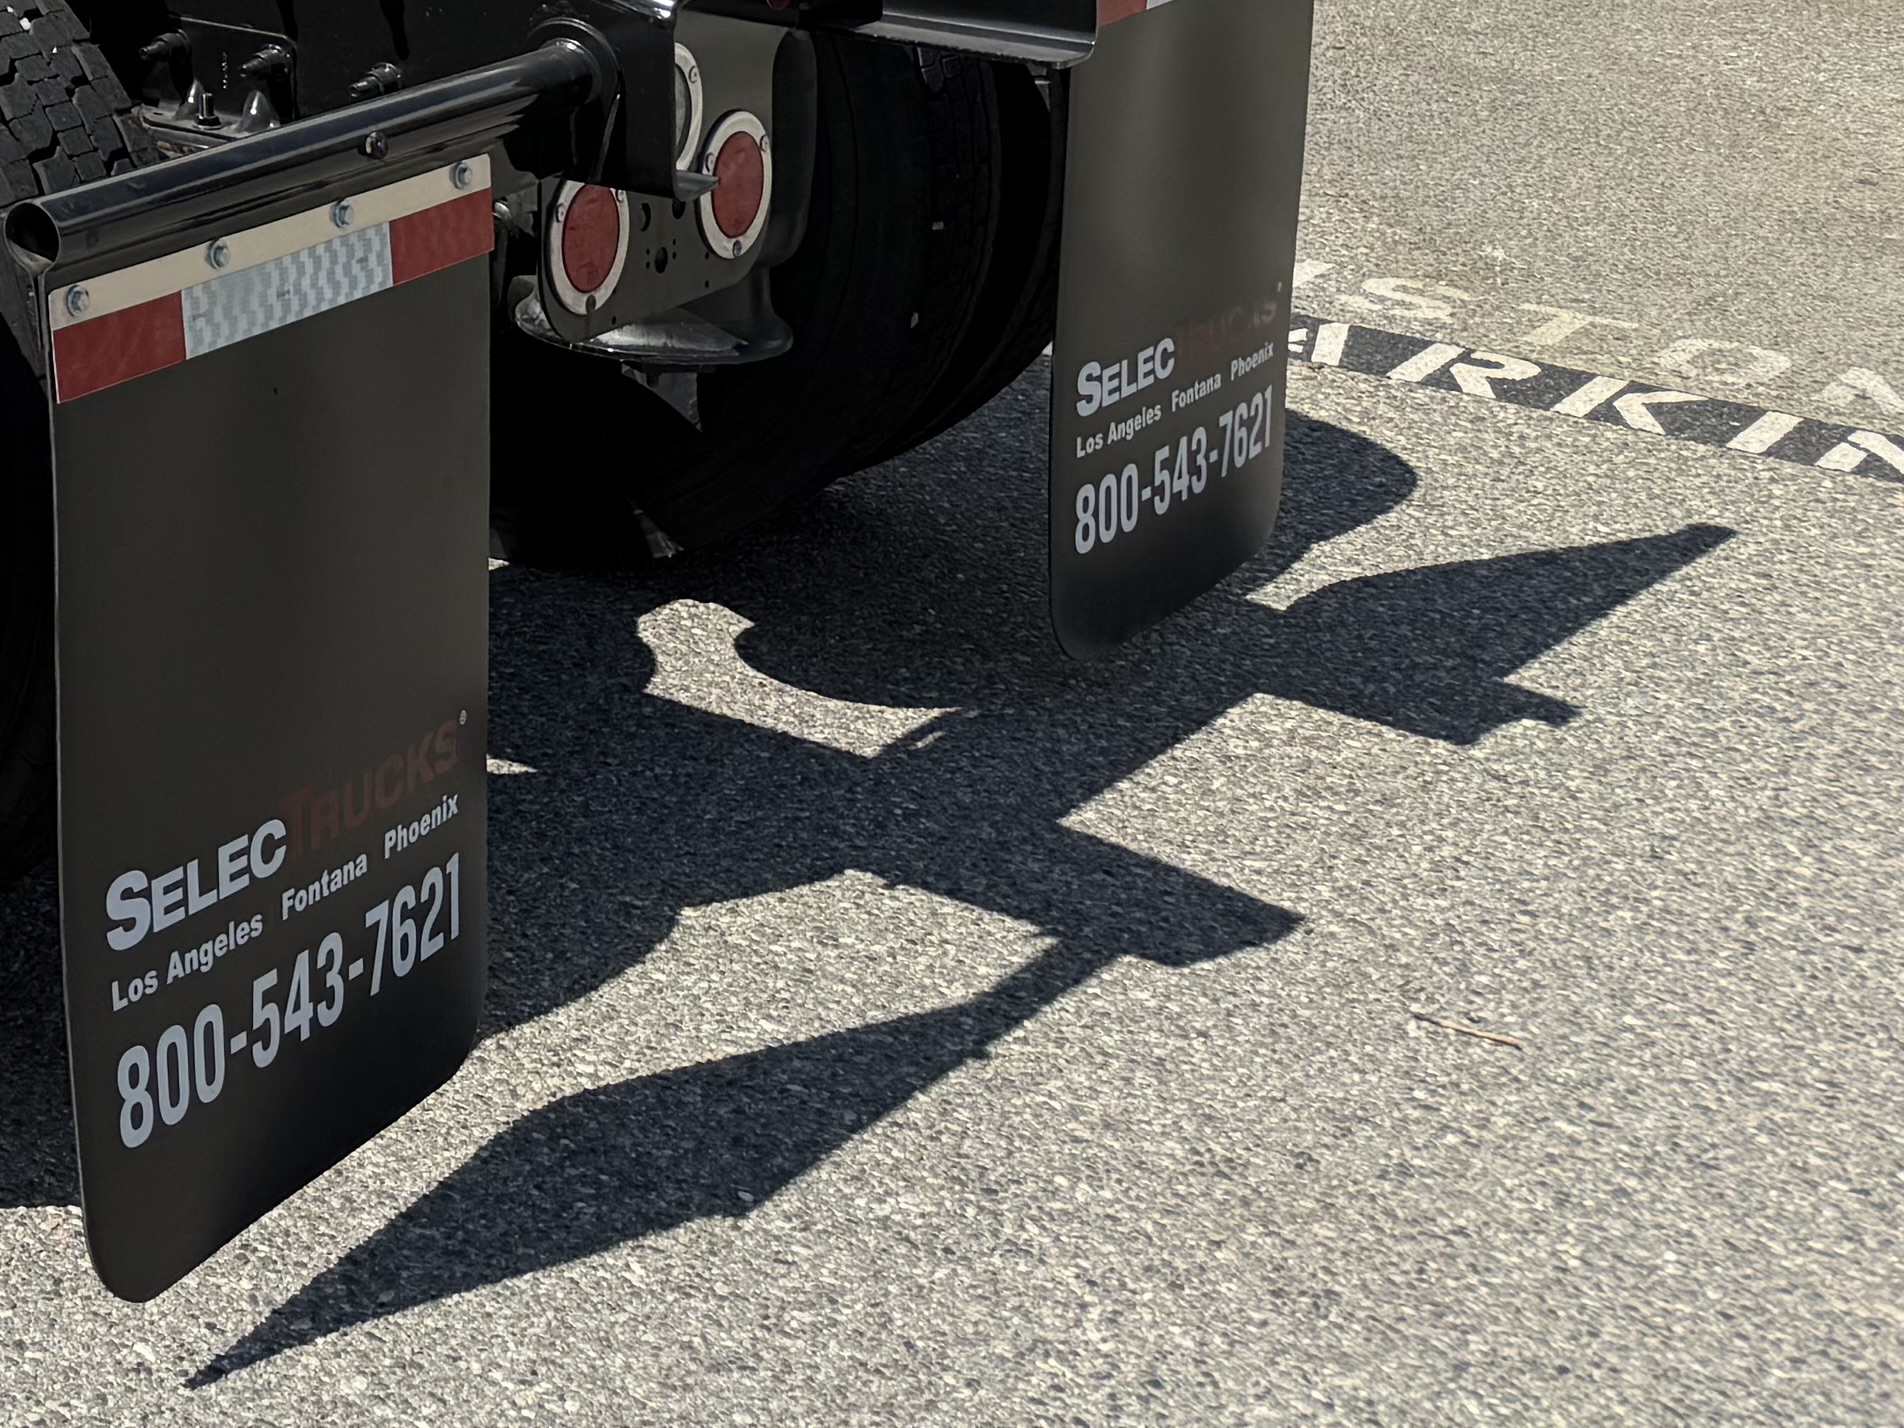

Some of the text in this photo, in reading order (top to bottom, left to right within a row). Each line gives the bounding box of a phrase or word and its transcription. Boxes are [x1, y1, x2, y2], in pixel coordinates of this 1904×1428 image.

[1075, 385, 1273, 555] 800-543-7621
[1076, 342, 1274, 458] Los Angeles Fontana Phoenix
[111, 794, 459, 1012] Los Angeles Fontana Phoenix
[117, 852, 460, 1148] 800-543-7621
